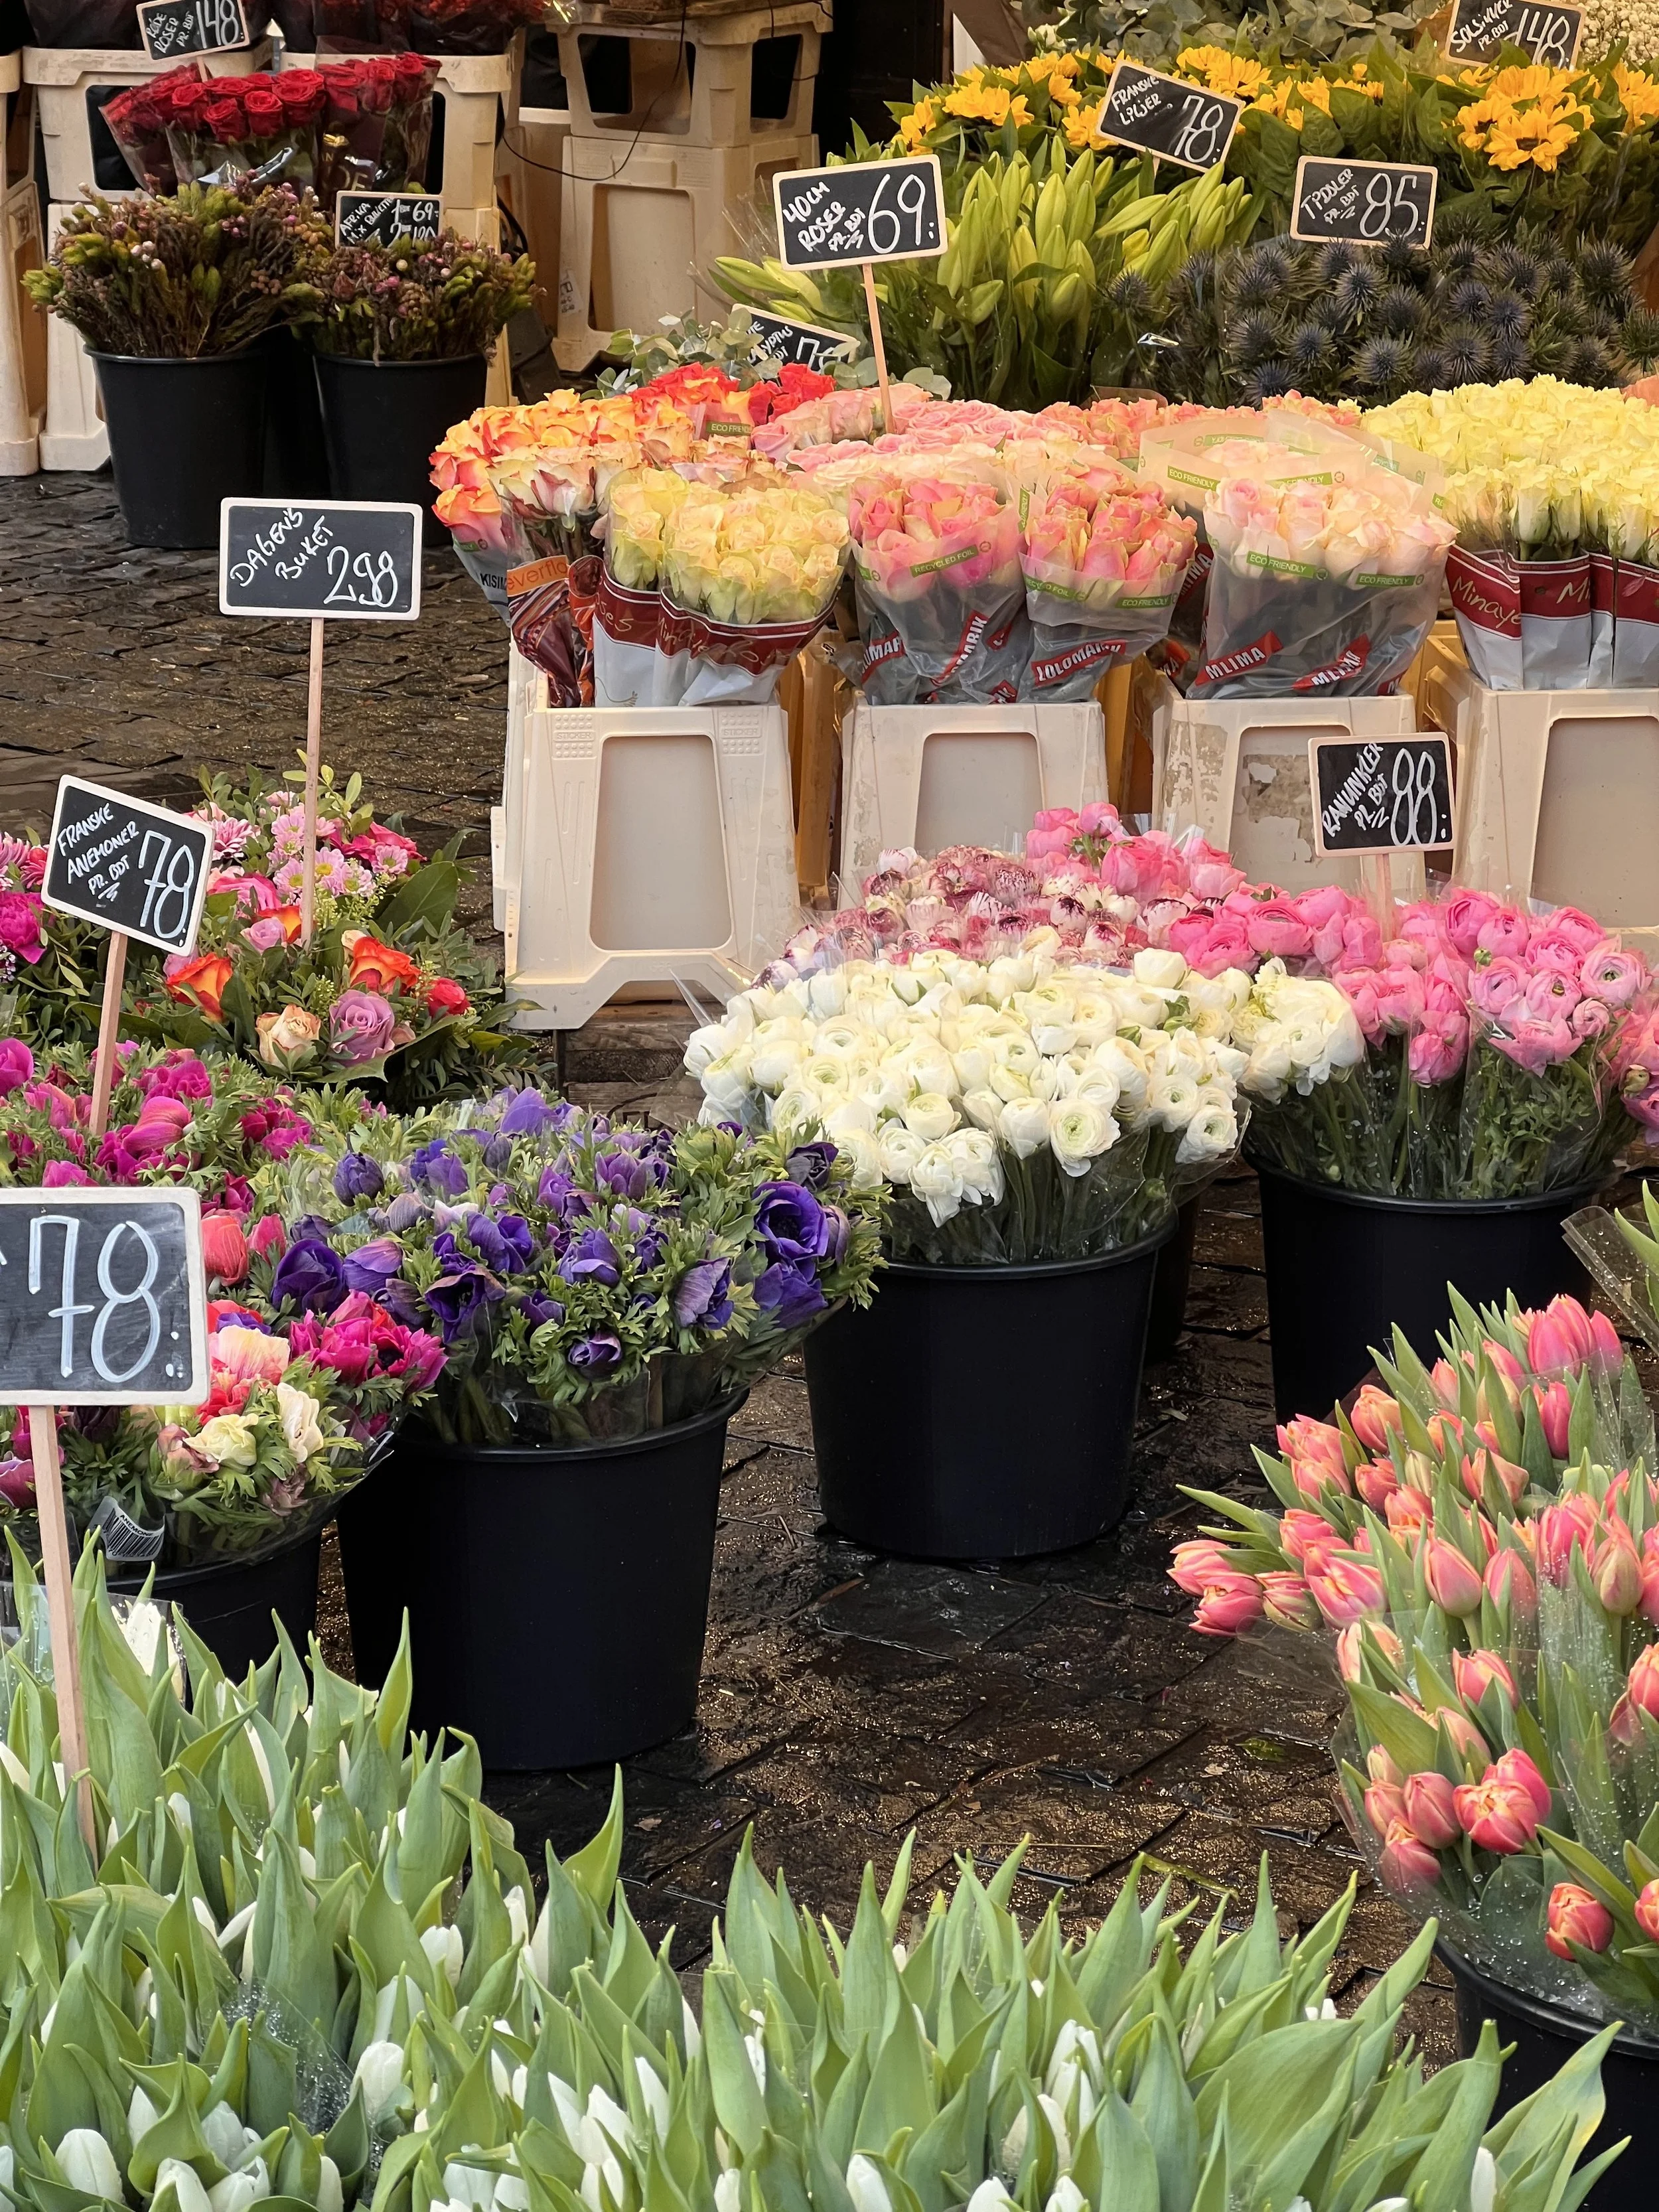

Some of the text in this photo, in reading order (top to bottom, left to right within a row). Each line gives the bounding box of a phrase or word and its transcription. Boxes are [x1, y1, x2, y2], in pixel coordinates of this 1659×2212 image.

[154, 17, 179, 53] ROSER
[798, 201, 846, 252] ROSER
[711, 423, 728, 432] ECO
[1169, 469, 1215, 488] ECO FRIENDLY
[275, 515, 333, 580] BUKET
[914, 549, 975, 574] RECYCLED FOIL
[1250, 554, 1306, 573] ECO FRIENDLY
[323, 546, 398, 608] 298
[1052, 585, 1069, 597] FOIL
[1377, 577, 1409, 585] FRIENDLY
[1204, 646, 1266, 680] MLIMA
[1311, 649, 1361, 686] MLIMA
[57, 803, 114, 857] FRANSKE
[68, 820, 140, 885] ANEMONER
[108, 854, 131, 881] BDT
